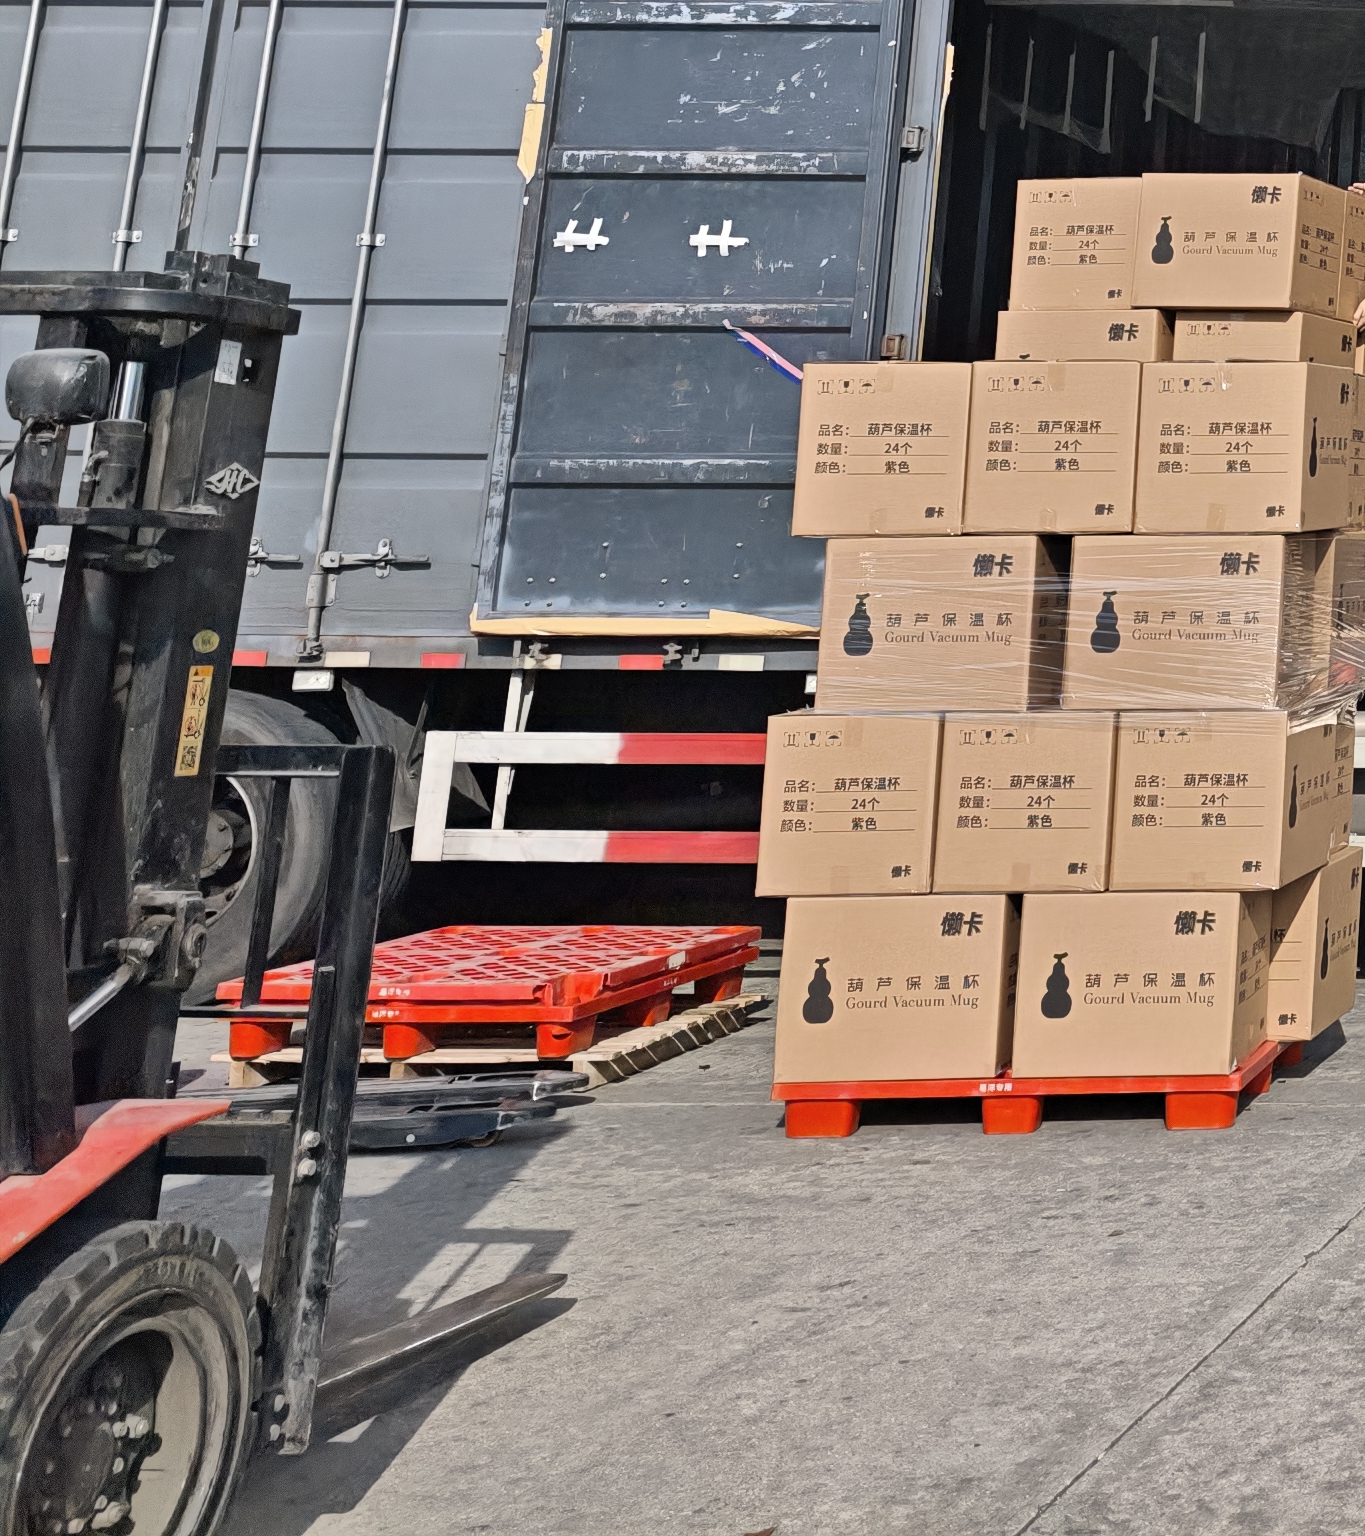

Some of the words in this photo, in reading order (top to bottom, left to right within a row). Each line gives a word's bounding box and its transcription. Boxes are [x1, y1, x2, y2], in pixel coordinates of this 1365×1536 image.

[1184, 232, 1279, 243] 葫芦保温杯
[1182, 246, 1212, 255] Gourd
[1216, 246, 1253, 255] Vacuum
[1258, 246, 1278, 257] Mug
[868, 423, 933, 436] 葫芦保温杯
[1038, 421, 1102, 433] 葫芦保温杯
[1208, 422, 1272, 435] 葫芦保温杯
[884, 442, 913, 454] 24个
[1054, 440, 1082, 452] 24个
[1225, 442, 1253, 454] 24个
[885, 461, 910, 473] 紫色
[1055, 458, 1080, 470] 紫色
[1226, 460, 1251, 472] 紫色
[886, 613, 1013, 627] 葫芦保温杯
[1133, 611, 1260, 625] 葫芦保温杯
[885, 631, 924, 643] Gourd
[930, 631, 979, 643] Vacuum
[984, 631, 1013, 646] Mug
[834, 777, 900, 791] 葫芦保温杯
[1010, 775, 1075, 788] 葫芦保温杯
[1183, 773, 1249, 786] 葫芦保温杯
[851, 797, 880, 810] 24个
[1027, 795, 1055, 808] 24个
[1201, 793, 1229, 806] 24个
[851, 818, 877, 831] 紫色
[1027, 814, 1052, 828] 紫色
[1201, 813, 1226, 826] 紫色
[847, 975, 980, 992] 葫芦保温杯
[1085, 972, 1216, 988] 葫芦保温杯
[846, 996, 887, 1009] Gourd
[893, 996, 945, 1008] Vacuum
[950, 994, 979, 1009] Mug
[1084, 992, 1124, 1005] Gourd
[1130, 992, 1181, 1004] Vacuum
[1186, 992, 1215, 1007] Mug
